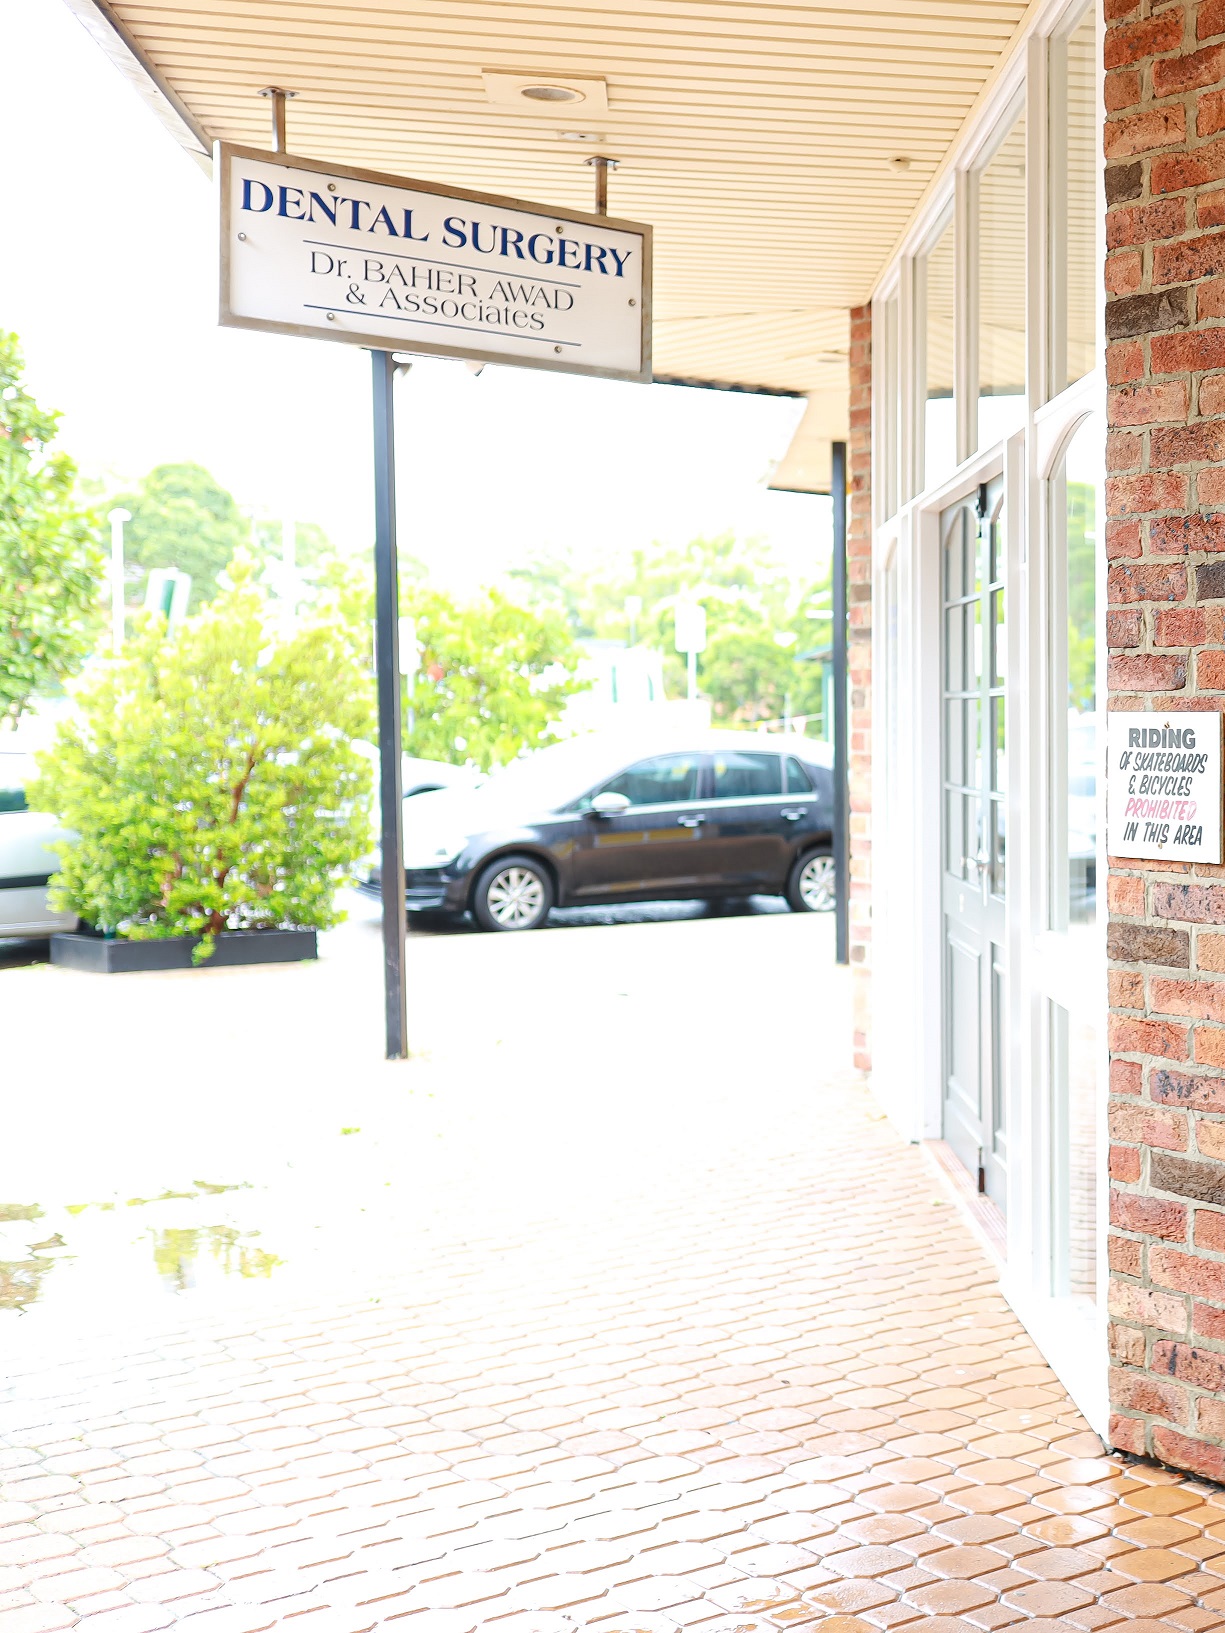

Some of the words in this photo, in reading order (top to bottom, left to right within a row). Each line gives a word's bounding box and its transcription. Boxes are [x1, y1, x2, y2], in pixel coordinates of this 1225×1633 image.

[241, 178, 429, 242] DENTAL
[442, 216, 633, 278] SURGERY
[310, 251, 351, 280] Dr.
[363, 259, 478, 297] BAHER
[489, 280, 574, 312] AWAD
[346, 283, 365, 304] &
[379, 287, 545, 330] Associates
[1128, 728, 1196, 749] RIDING
[1119, 751, 1133, 771] OF
[1133, 751, 1208, 774] SKATEBOARDS
[1128, 774, 1136, 795] &
[1139, 774, 1192, 796] BICYCLES
[1124, 797, 1197, 821] PROHIBITED
[1123, 821, 1139, 842] IN
[1143, 821, 1170, 844] THIS
[1173, 824, 1203, 846] AREA
